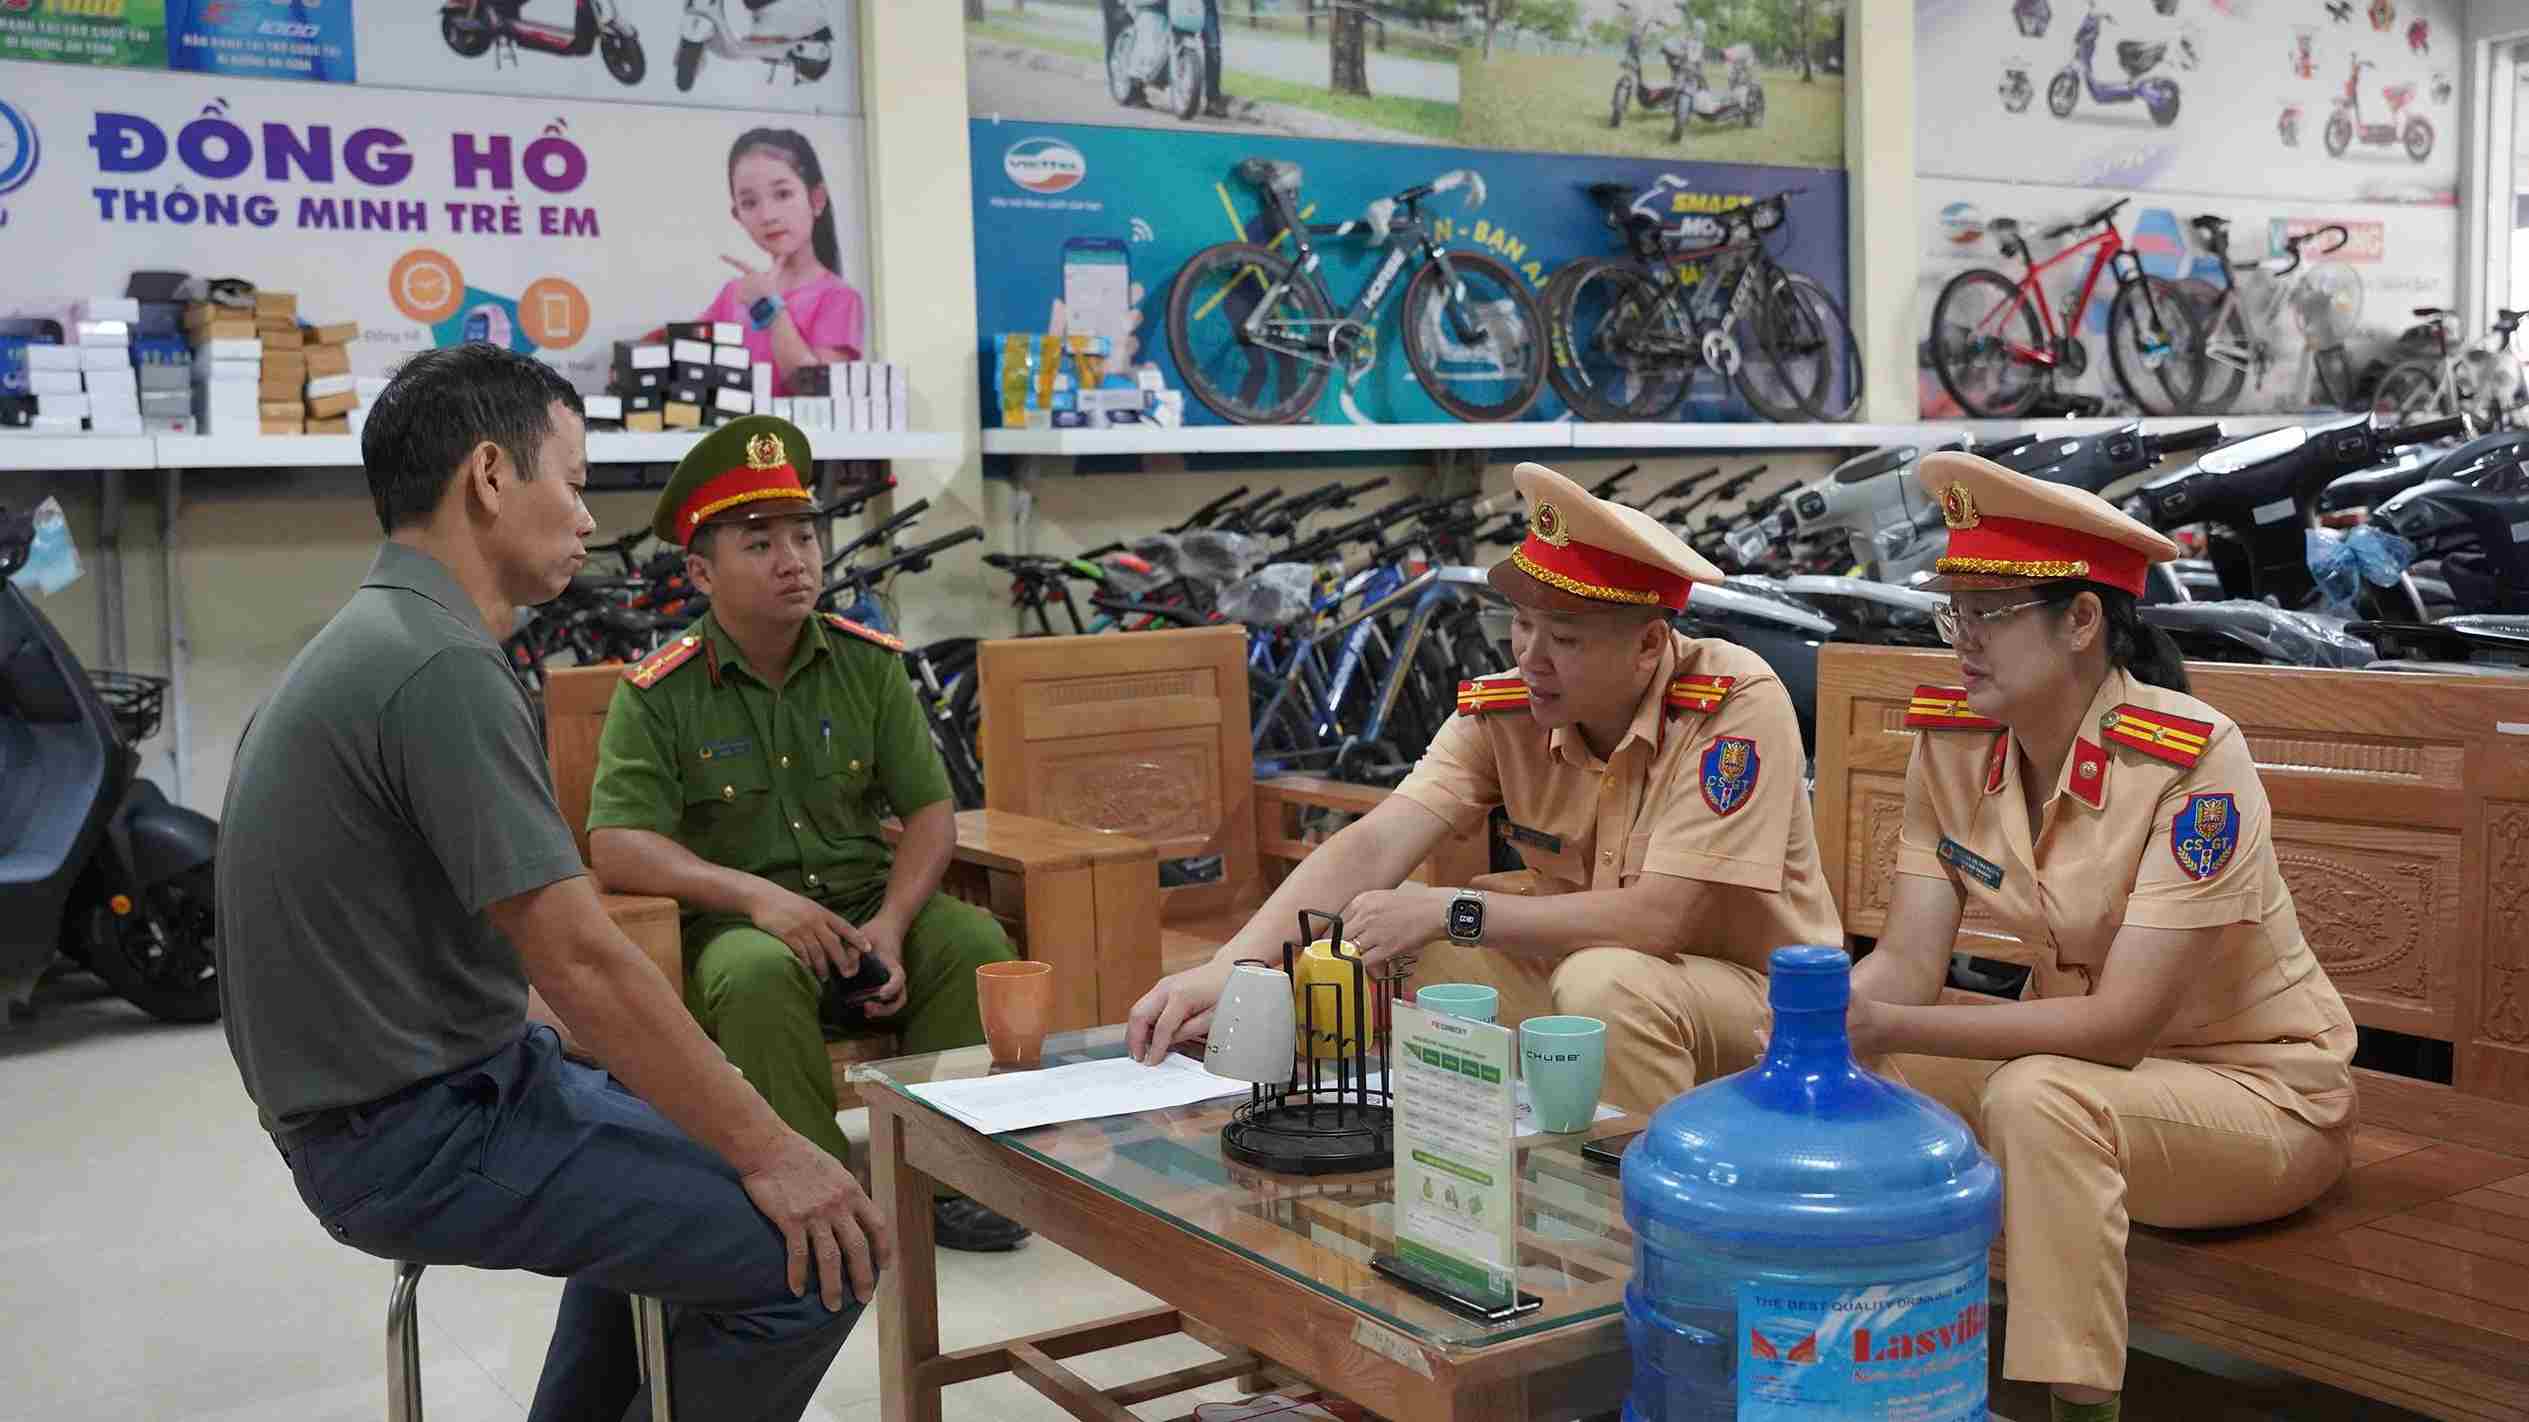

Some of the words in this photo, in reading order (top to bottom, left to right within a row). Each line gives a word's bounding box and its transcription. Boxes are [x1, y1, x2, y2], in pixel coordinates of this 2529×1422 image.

[88, 97, 414, 187] ĐỒNG
[452, 117, 588, 193] HỒ
[93, 183, 278, 228] THÔNG
[297, 197, 427, 232] MINH
[538, 205, 600, 237] EM
[1754, 1296, 1784, 1309] THE
[1787, 1300, 1826, 1313] BEST
